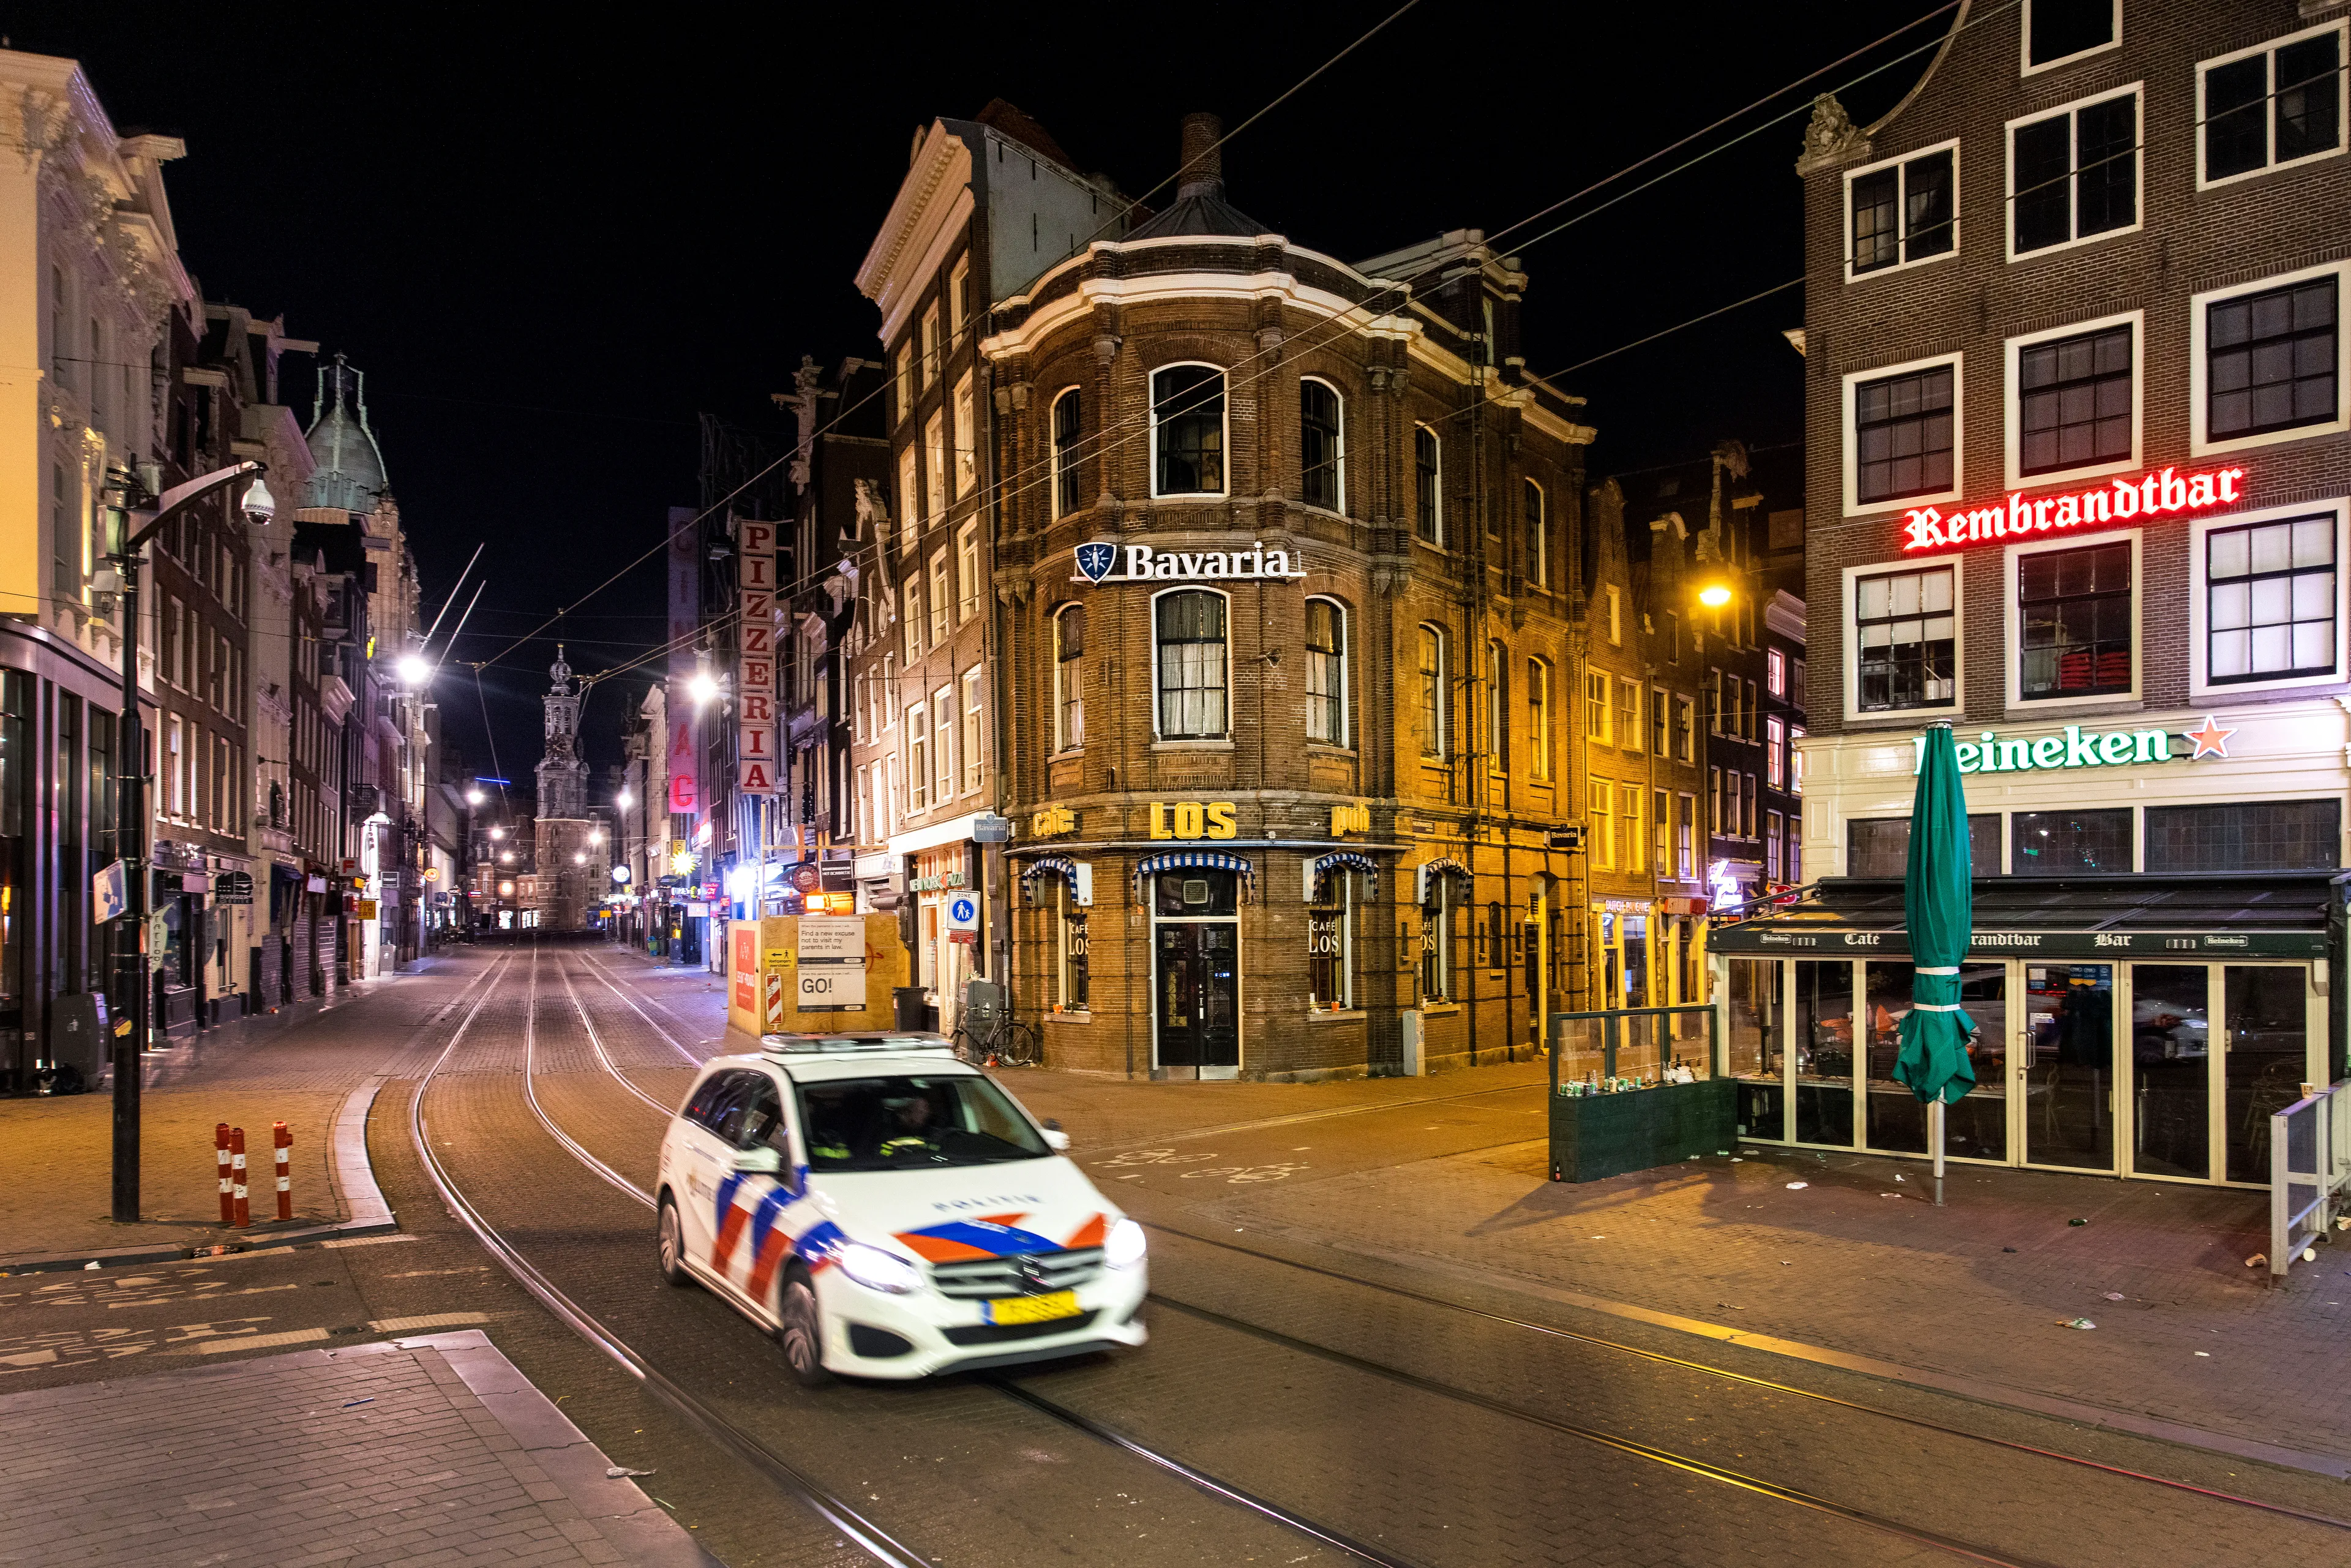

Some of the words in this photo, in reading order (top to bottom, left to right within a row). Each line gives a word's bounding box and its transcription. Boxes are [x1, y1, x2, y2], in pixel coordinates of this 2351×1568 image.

[1903, 467, 2243, 551] Rembrandtbar
[1125, 541, 1290, 580] Bavaria
[673, 519, 693, 808] CINAC
[744, 526, 771, 788] PIZZERIA
[1150, 801, 1236, 839] LOS
[1332, 801, 1370, 836] pub
[342, 860, 355, 873] F
[947, 872, 966, 887] PIZZA
[1605, 899, 1625, 911] DUTCH
[1309, 920, 1339, 953] LOS
[1311, 920, 1335, 931] CAFÉ
[1420, 934, 1435, 950] OS
[1845, 933, 1880, 945] Café
[2094, 934, 2132, 947] Bar
[802, 978, 832, 993] GO!
